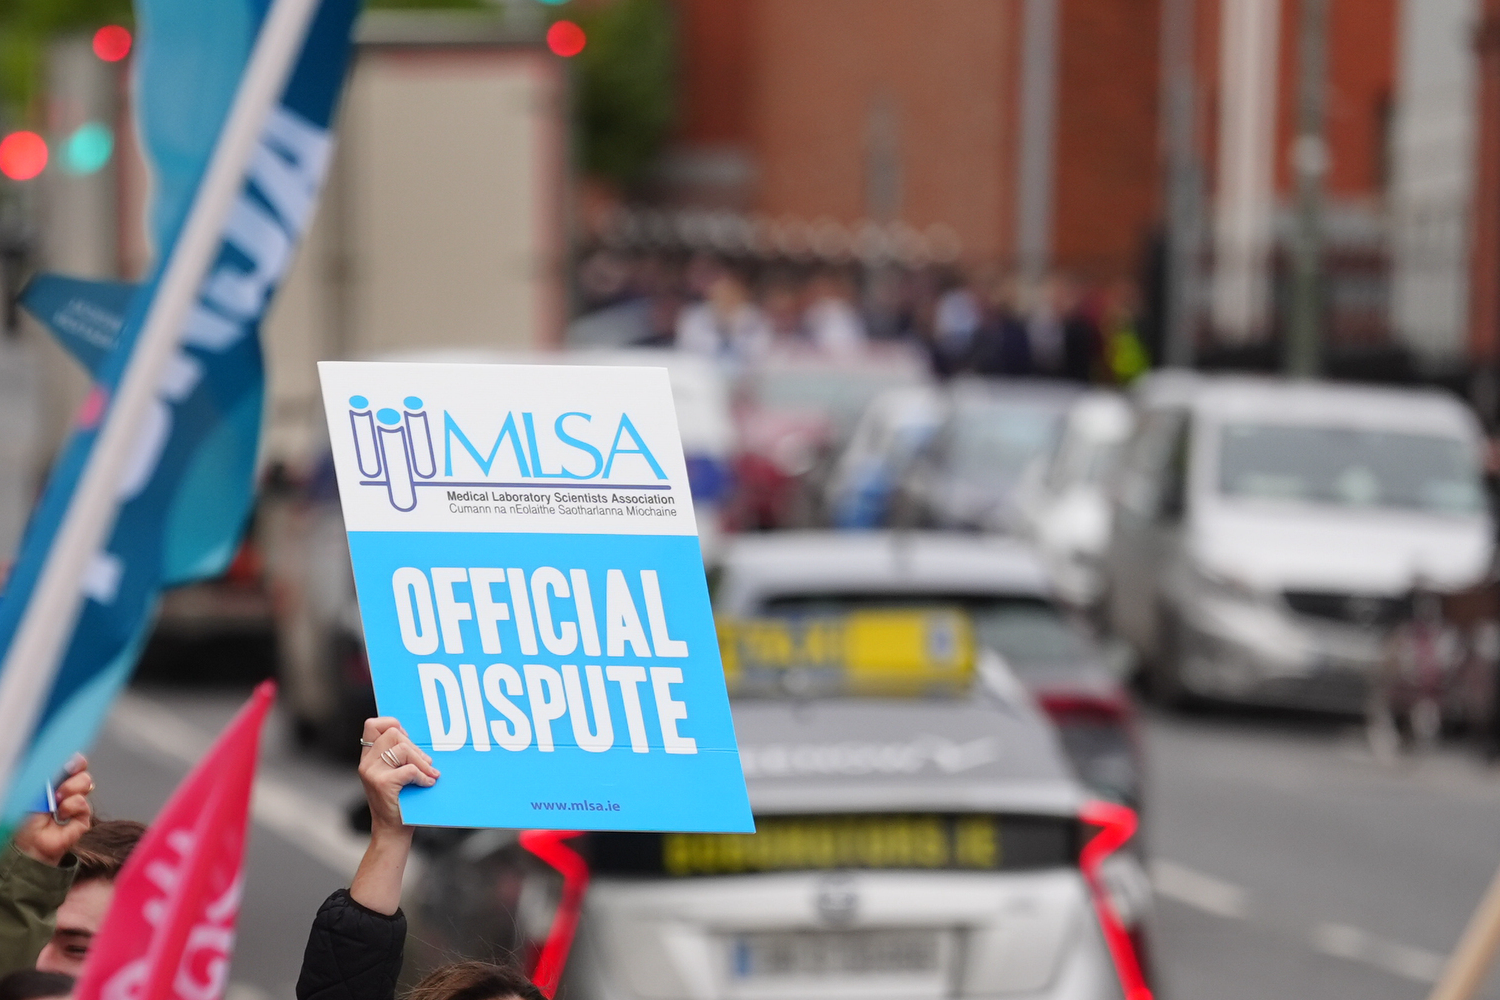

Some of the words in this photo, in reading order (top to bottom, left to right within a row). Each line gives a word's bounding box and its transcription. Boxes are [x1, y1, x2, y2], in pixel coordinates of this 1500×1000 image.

[443, 408, 669, 481] MLSA
[447, 490, 490, 503] Medical
[492, 491, 552, 506] Laboratory
[554, 492, 609, 505] Scientists
[611, 493, 675, 506] Association
[449, 504, 491, 515] Cumann
[494, 506, 508, 515] na
[509, 504, 556, 516] nEolaithe
[558, 504, 624, 516] Saotharlanna
[391, 566, 689, 657] OFFICIAL
[417, 663, 698, 754] DISPUTE
[531, 800, 621, 812] www.mlsa.ie
